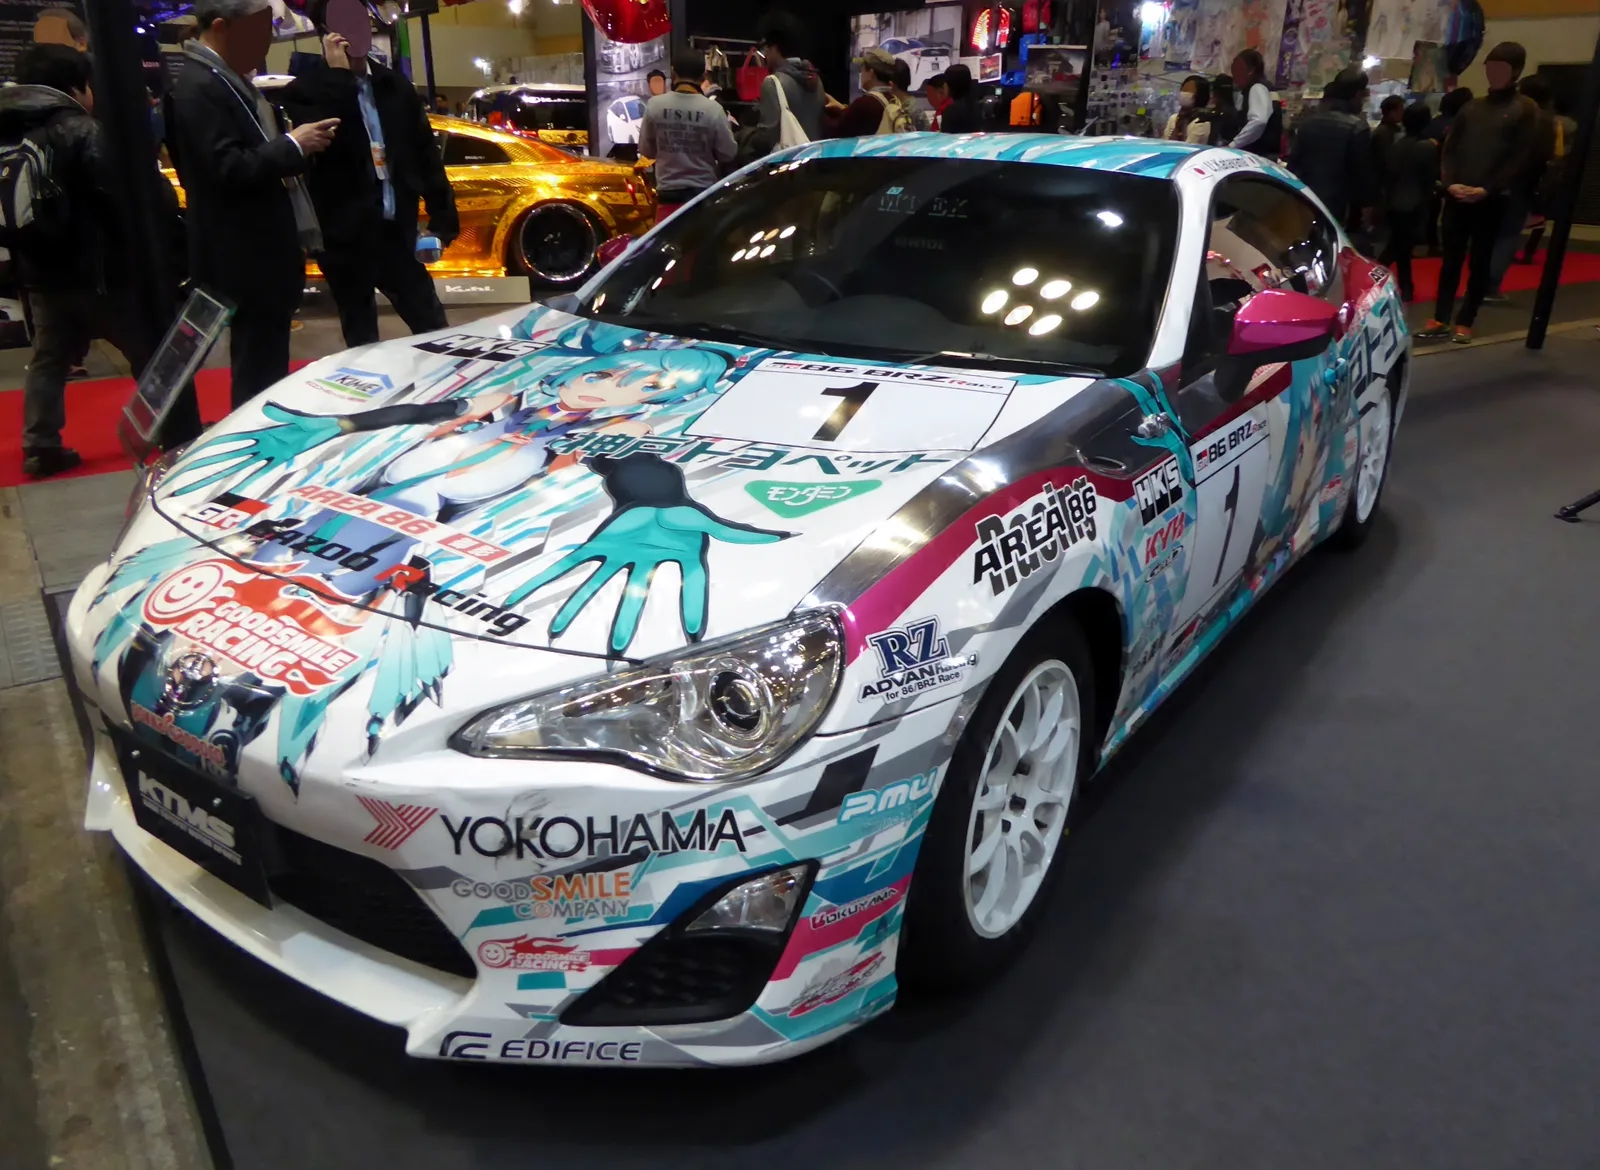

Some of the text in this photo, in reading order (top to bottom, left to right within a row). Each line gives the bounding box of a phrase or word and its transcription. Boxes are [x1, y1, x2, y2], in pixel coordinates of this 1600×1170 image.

[428, 335, 553, 361] HKS
[800, 364, 856, 374] 86
[863, 368, 949, 383] BRZ
[948, 379, 1004, 390] Race
[812, 382, 880, 442] 1
[556, 431, 949, 475] 神戸トヨペット
[1208, 437, 1227, 463] 86
[1228, 420, 1252, 450] BRZ
[766, 486, 851, 507] モンダミン
[1134, 457, 1182, 512] HKS
[287, 485, 438, 535] AREA 86
[1212, 464, 1240, 587] 1
[973, 486, 1097, 585] AREA 86
[176, 611, 298, 678] RACING
[869, 618, 950, 679] RZ
[861, 664, 936, 700] ADVAN
[885, 671, 960, 701] for 86/BRZ Race
[138, 769, 236, 848] KTMS
[440, 808, 747, 860] YOKOHAMA
[500, 1040, 641, 1061] EDIFICE
